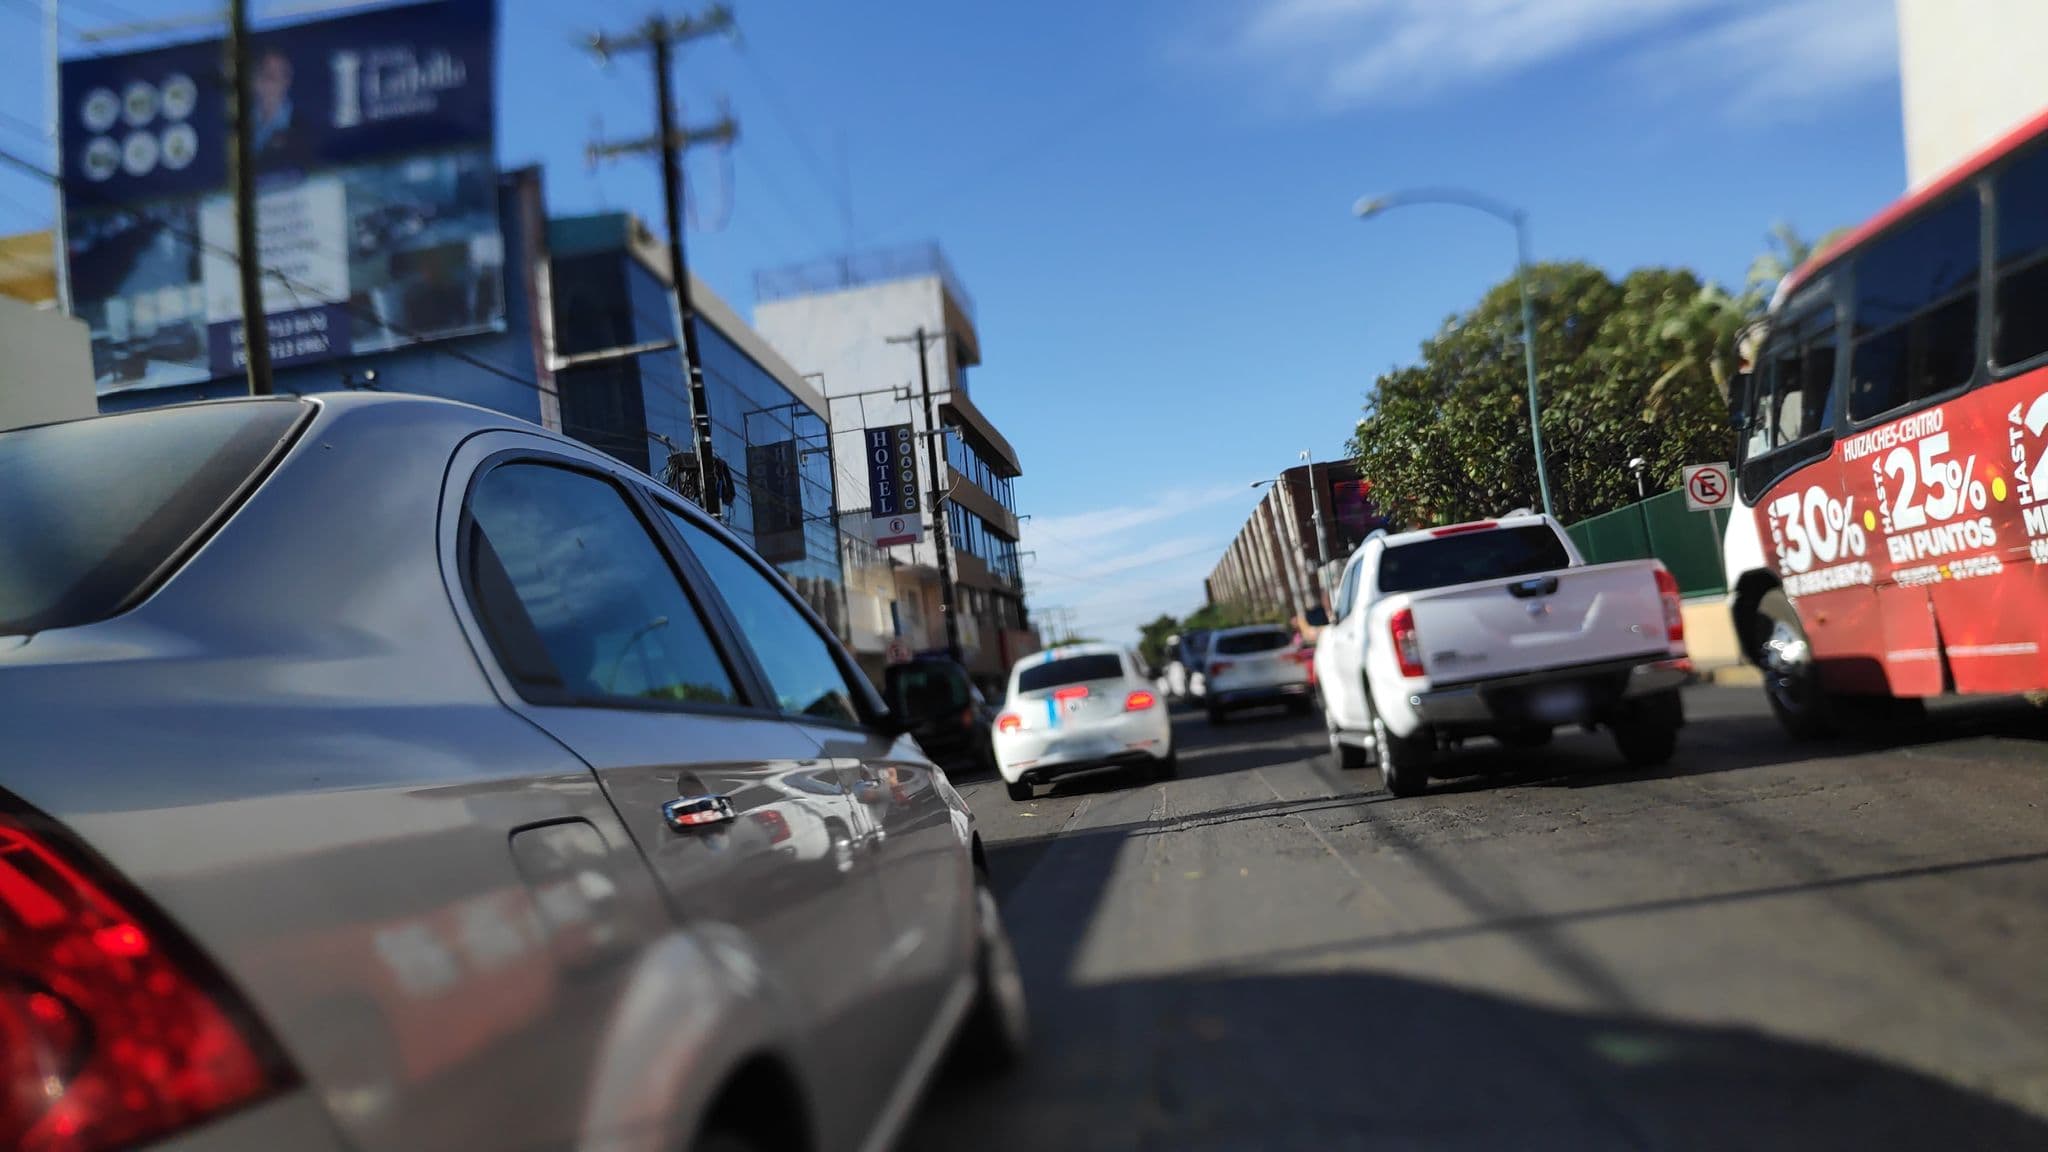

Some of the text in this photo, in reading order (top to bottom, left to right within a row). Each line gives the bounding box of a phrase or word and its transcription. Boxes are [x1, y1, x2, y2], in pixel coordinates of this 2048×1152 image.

[873, 431, 893, 513] HOTEL
[1844, 408, 1943, 462] HUIZACHES-CENTRO
[2008, 402, 2033, 506] HASTA
[1872, 456, 1894, 535] HASTA
[1884, 431, 1987, 531] 25%
[1775, 485, 1866, 573] 30%
[1886, 533, 1916, 564] EN
[1913, 516, 1997, 559] PUNTOS
